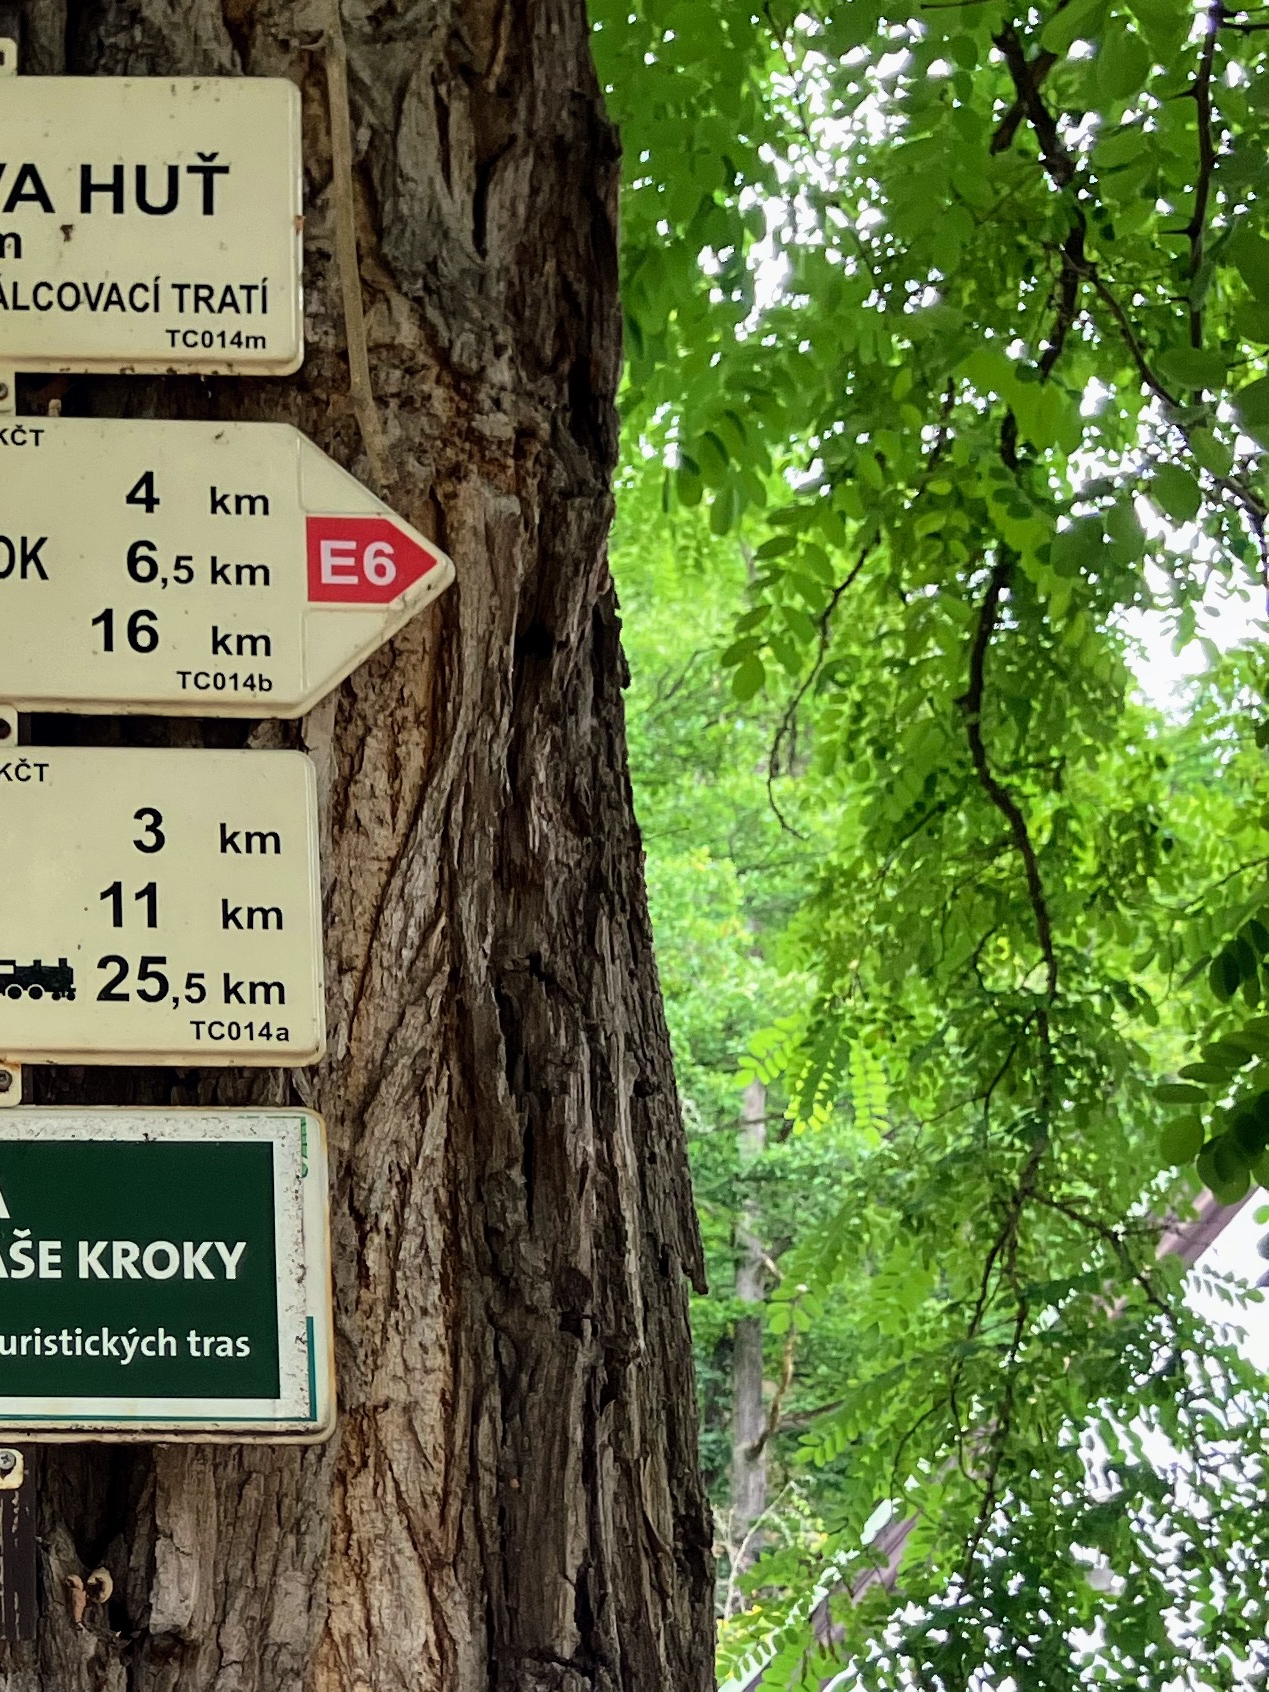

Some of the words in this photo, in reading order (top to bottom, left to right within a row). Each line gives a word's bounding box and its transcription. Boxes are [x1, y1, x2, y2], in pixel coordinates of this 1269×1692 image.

[80, 151, 230, 216] HUŤ
[171, 276, 268, 315] TRATÍ
[165, 329, 266, 349] TC014m
[125, 470, 161, 514] 4
[210, 485, 270, 516] km
[126, 539, 194, 590] 6,5
[210, 555, 270, 587] km
[320, 539, 397, 586] E6
[91, 608, 159, 654] 16
[211, 625, 272, 657] km
[176, 670, 273, 692] TC014b
[133, 807, 166, 854] 3
[219, 822, 281, 855] km
[99, 880, 158, 929] 11
[221, 898, 283, 931] km
[96, 954, 207, 1010] 25,5
[223, 972, 286, 1005] km
[189, 1020, 290, 1042] TC014a
[78, 1240, 247, 1280] KROKY
[186, 1329, 251, 1357] tras
